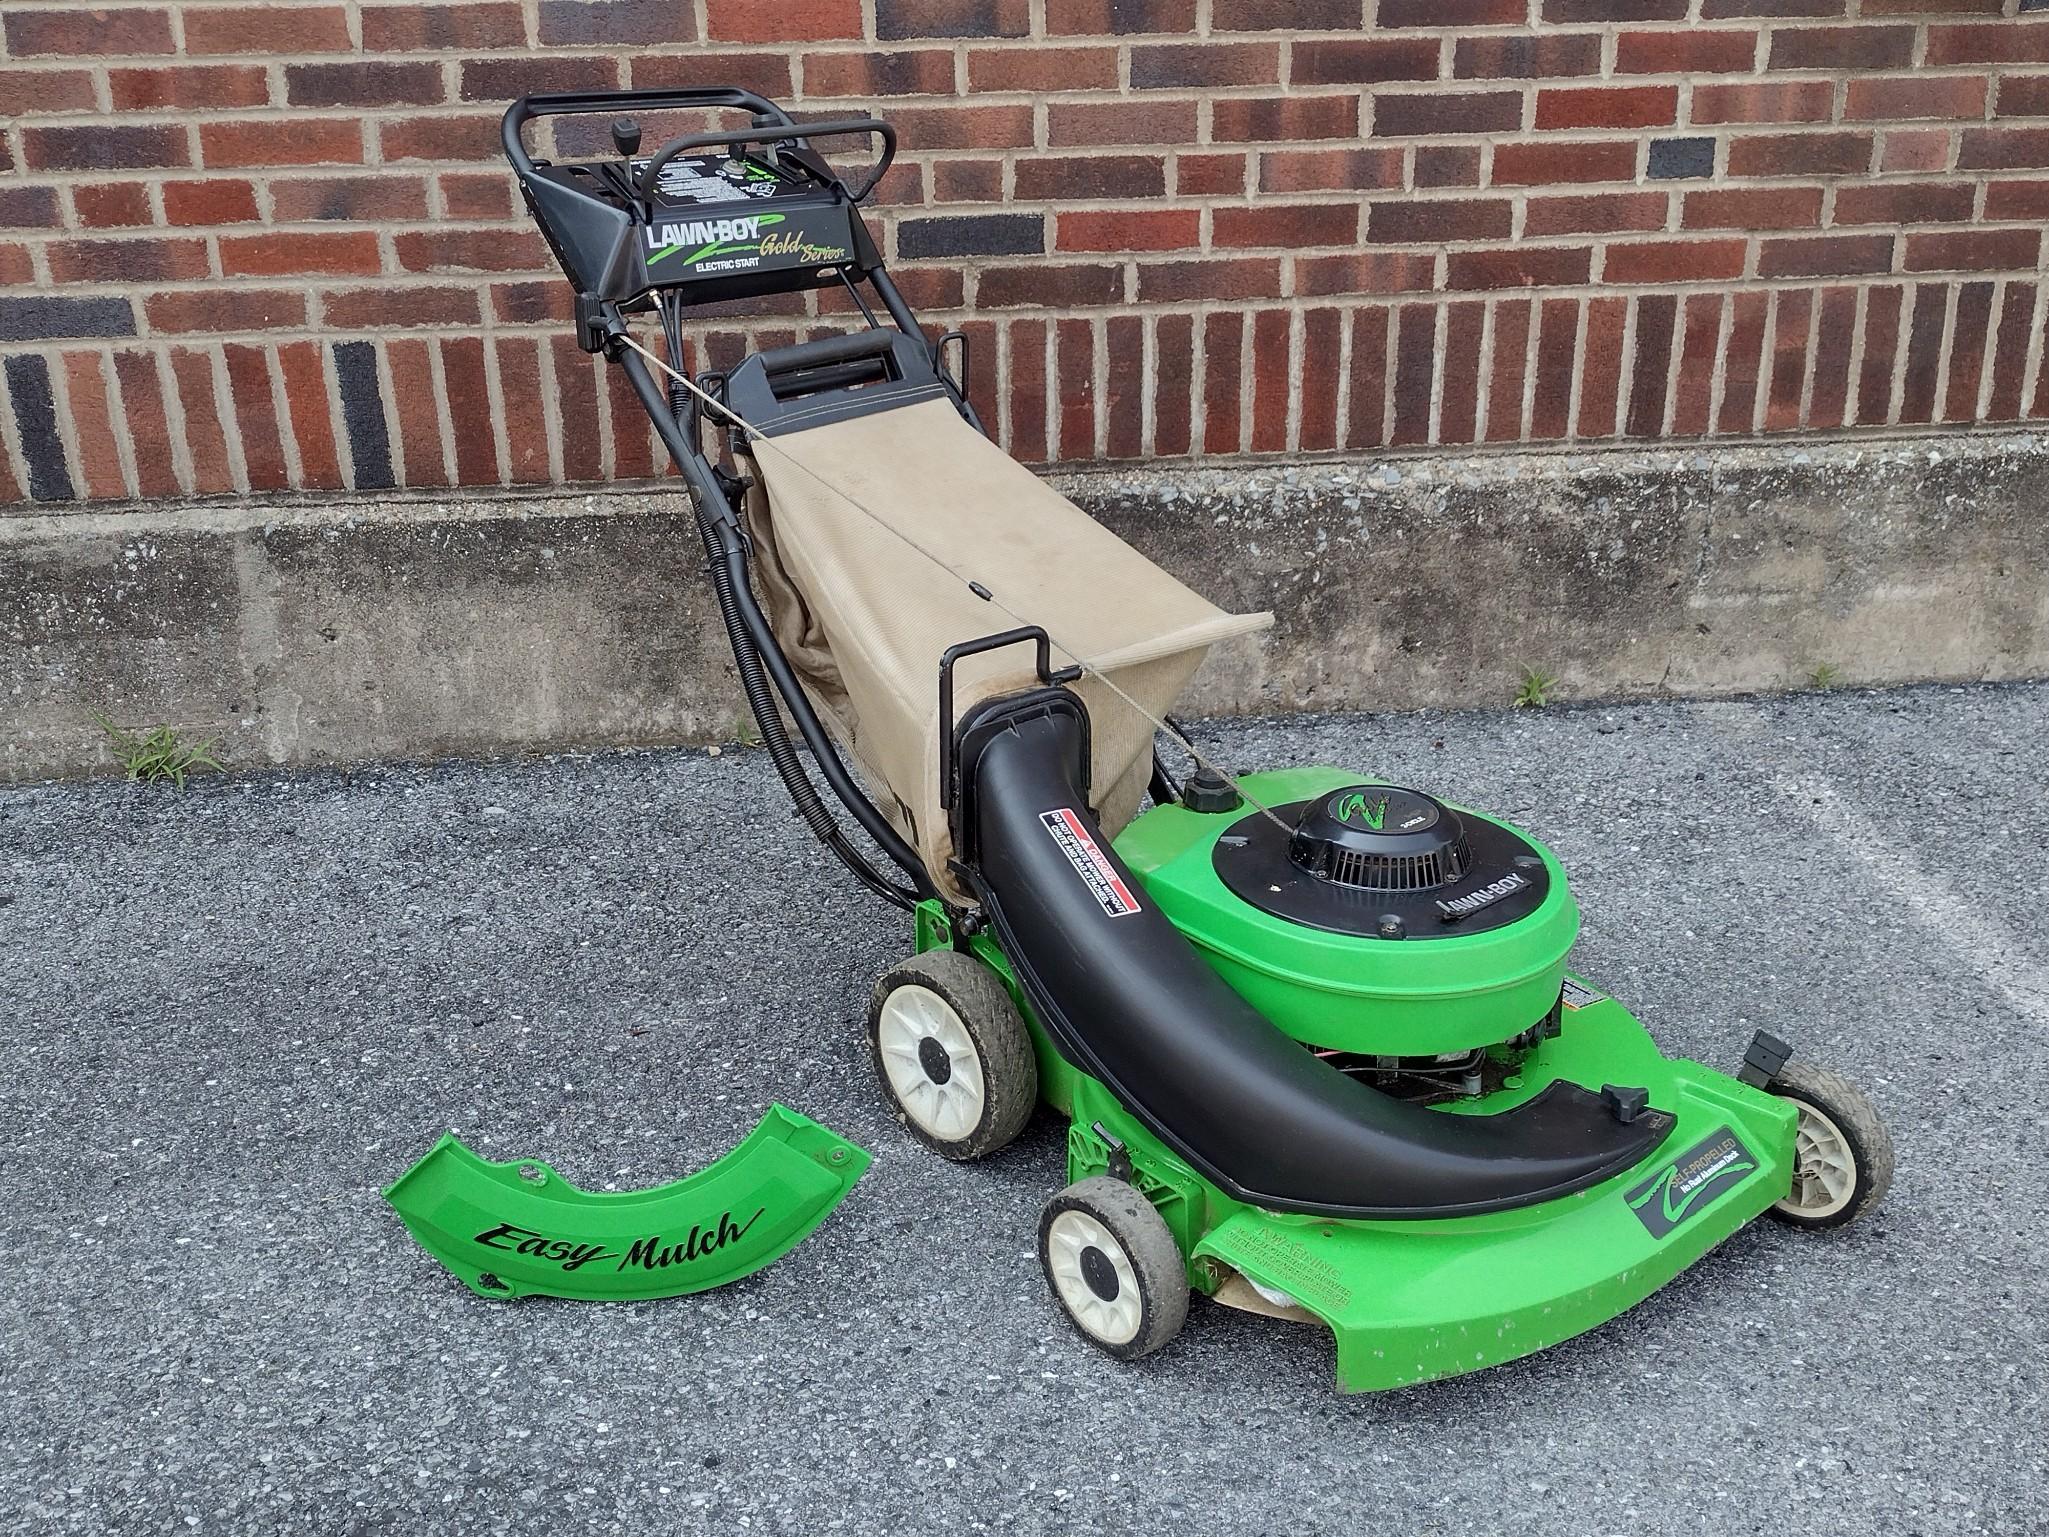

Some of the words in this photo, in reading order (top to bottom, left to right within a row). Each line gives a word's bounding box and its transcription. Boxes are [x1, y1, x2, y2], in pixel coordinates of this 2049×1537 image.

[696, 260, 734, 273] ELECTRIC
[735, 257, 760, 270] START
[759, 231, 804, 257] Gold
[800, 243, 841, 263] Series
[1051, 813, 1062, 824] DO
[1058, 823, 1071, 836] NOT
[1066, 835, 1090, 863] OPERATE
[1086, 862, 1106, 885] MOWER
[1102, 883, 1126, 912] WITHOUT
[1051, 825, 1069, 846] CHUTE
[1065, 845, 1078, 858] AND
[1074, 857, 1088, 871] BAG
[1083, 871, 1110, 903] ATTACHED.
[1087, 848, 1116, 881] DANGER
[1670, 1138, 1737, 1188] SELF-PROPELLED
[1679, 1182, 1692, 1193] No
[1687, 1174, 1703, 1187] Rust
[1698, 1157, 1727, 1180] Aluminum
[1722, 1148, 1740, 1163] Deck
[474, 1222, 619, 1271] Easy
[617, 1207, 765, 1272] Mulch
